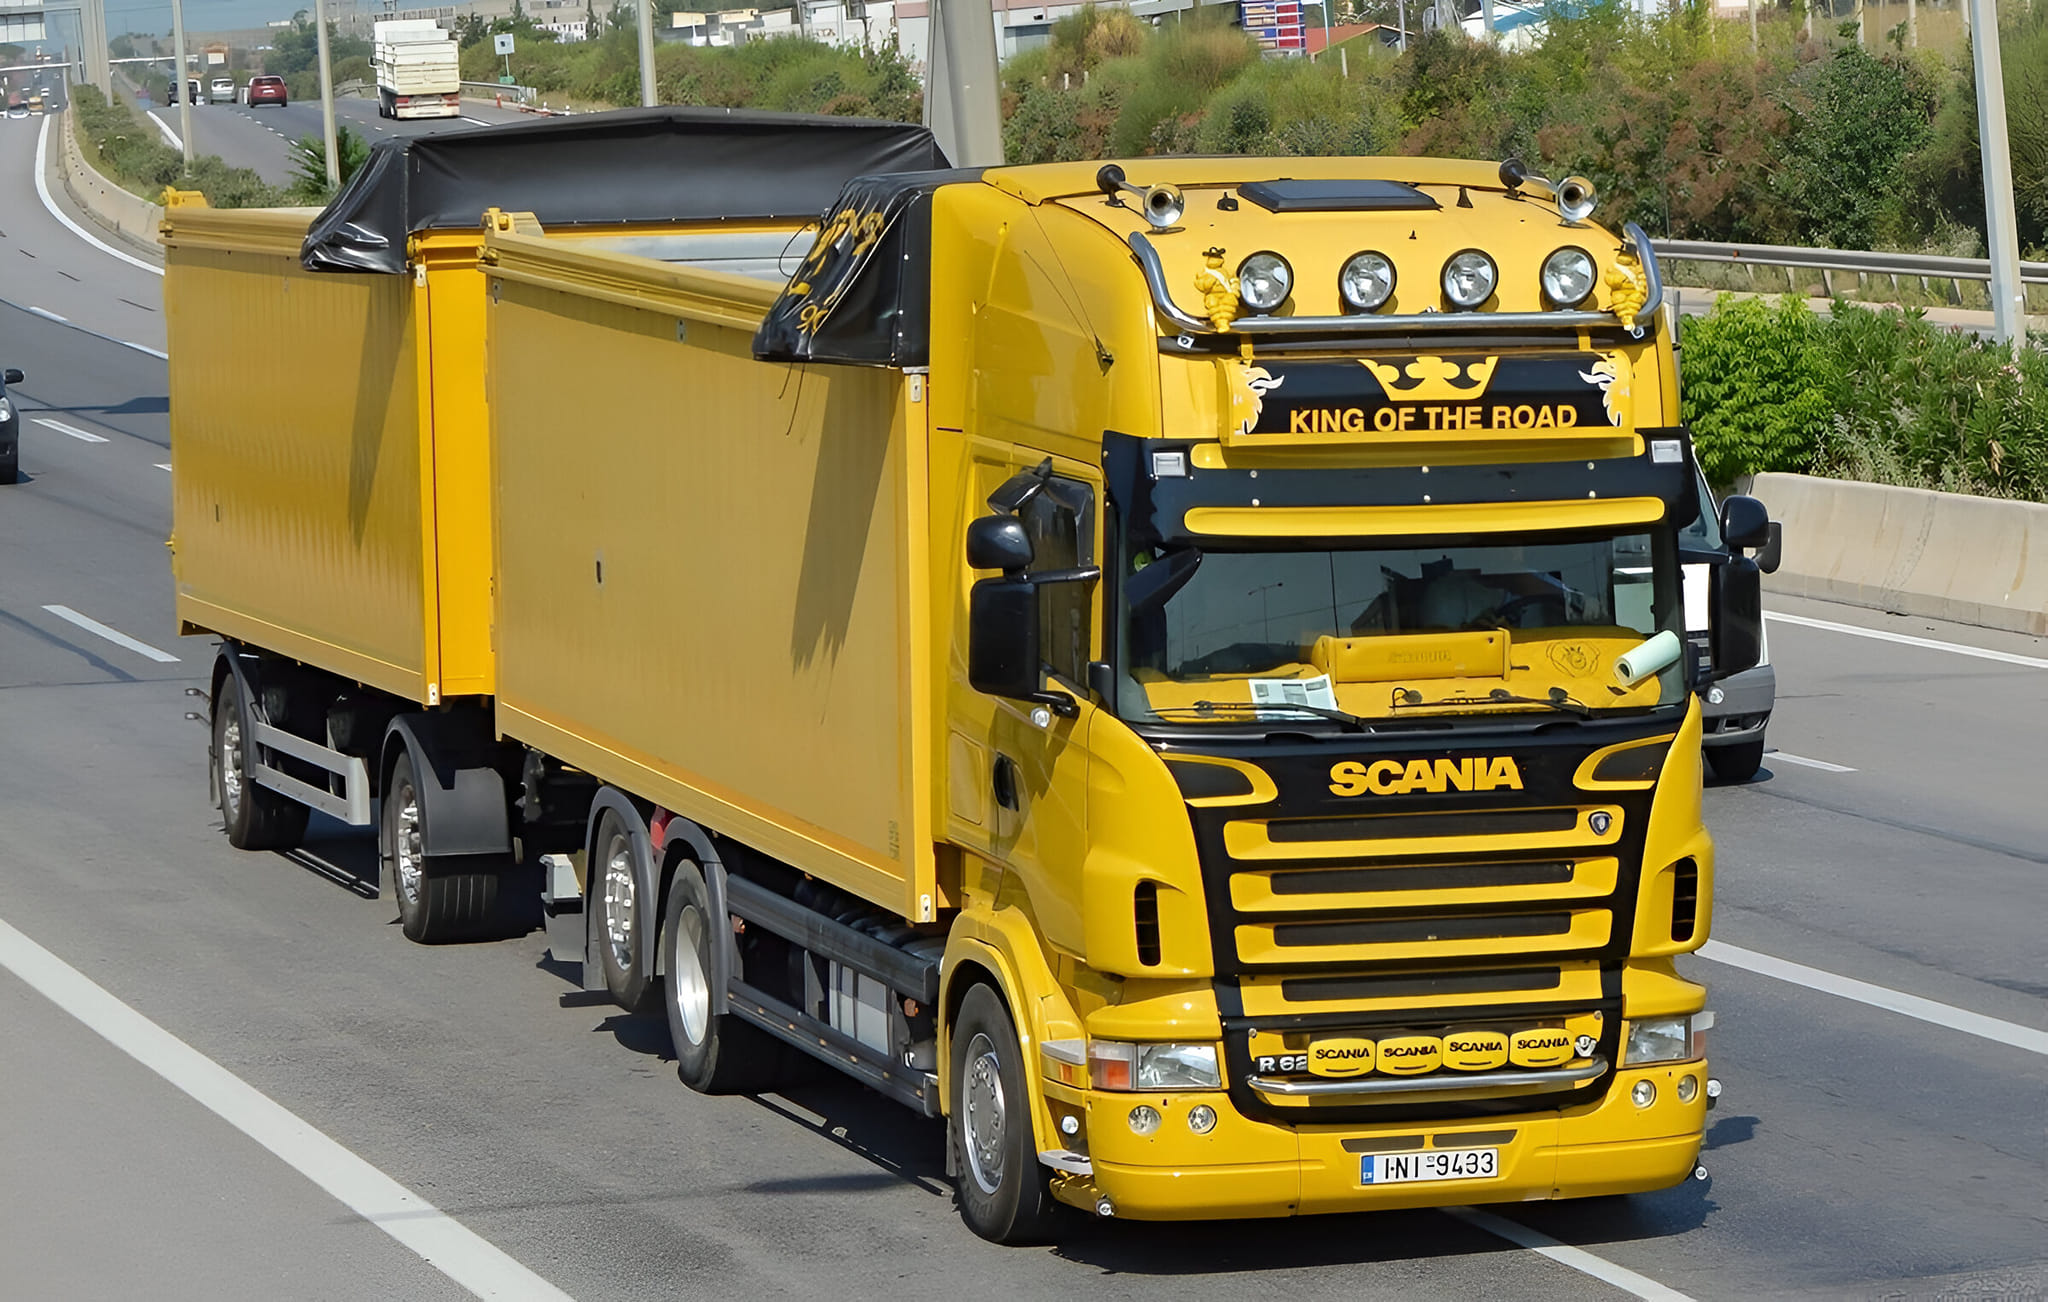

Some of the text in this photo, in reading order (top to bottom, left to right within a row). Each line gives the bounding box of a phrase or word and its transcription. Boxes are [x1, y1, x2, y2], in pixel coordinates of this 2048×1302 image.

[1290, 404, 1578, 434] KING OF THE ROAD
[1328, 756, 1525, 798] SCANIA
[1449, 1041, 1503, 1052] SCANIA
[1516, 1037, 1570, 1050] SCANIA
[1315, 1047, 1370, 1060] SCANIA
[1383, 1044, 1438, 1058] SCANIA
[1259, 1056, 1276, 1073] R
